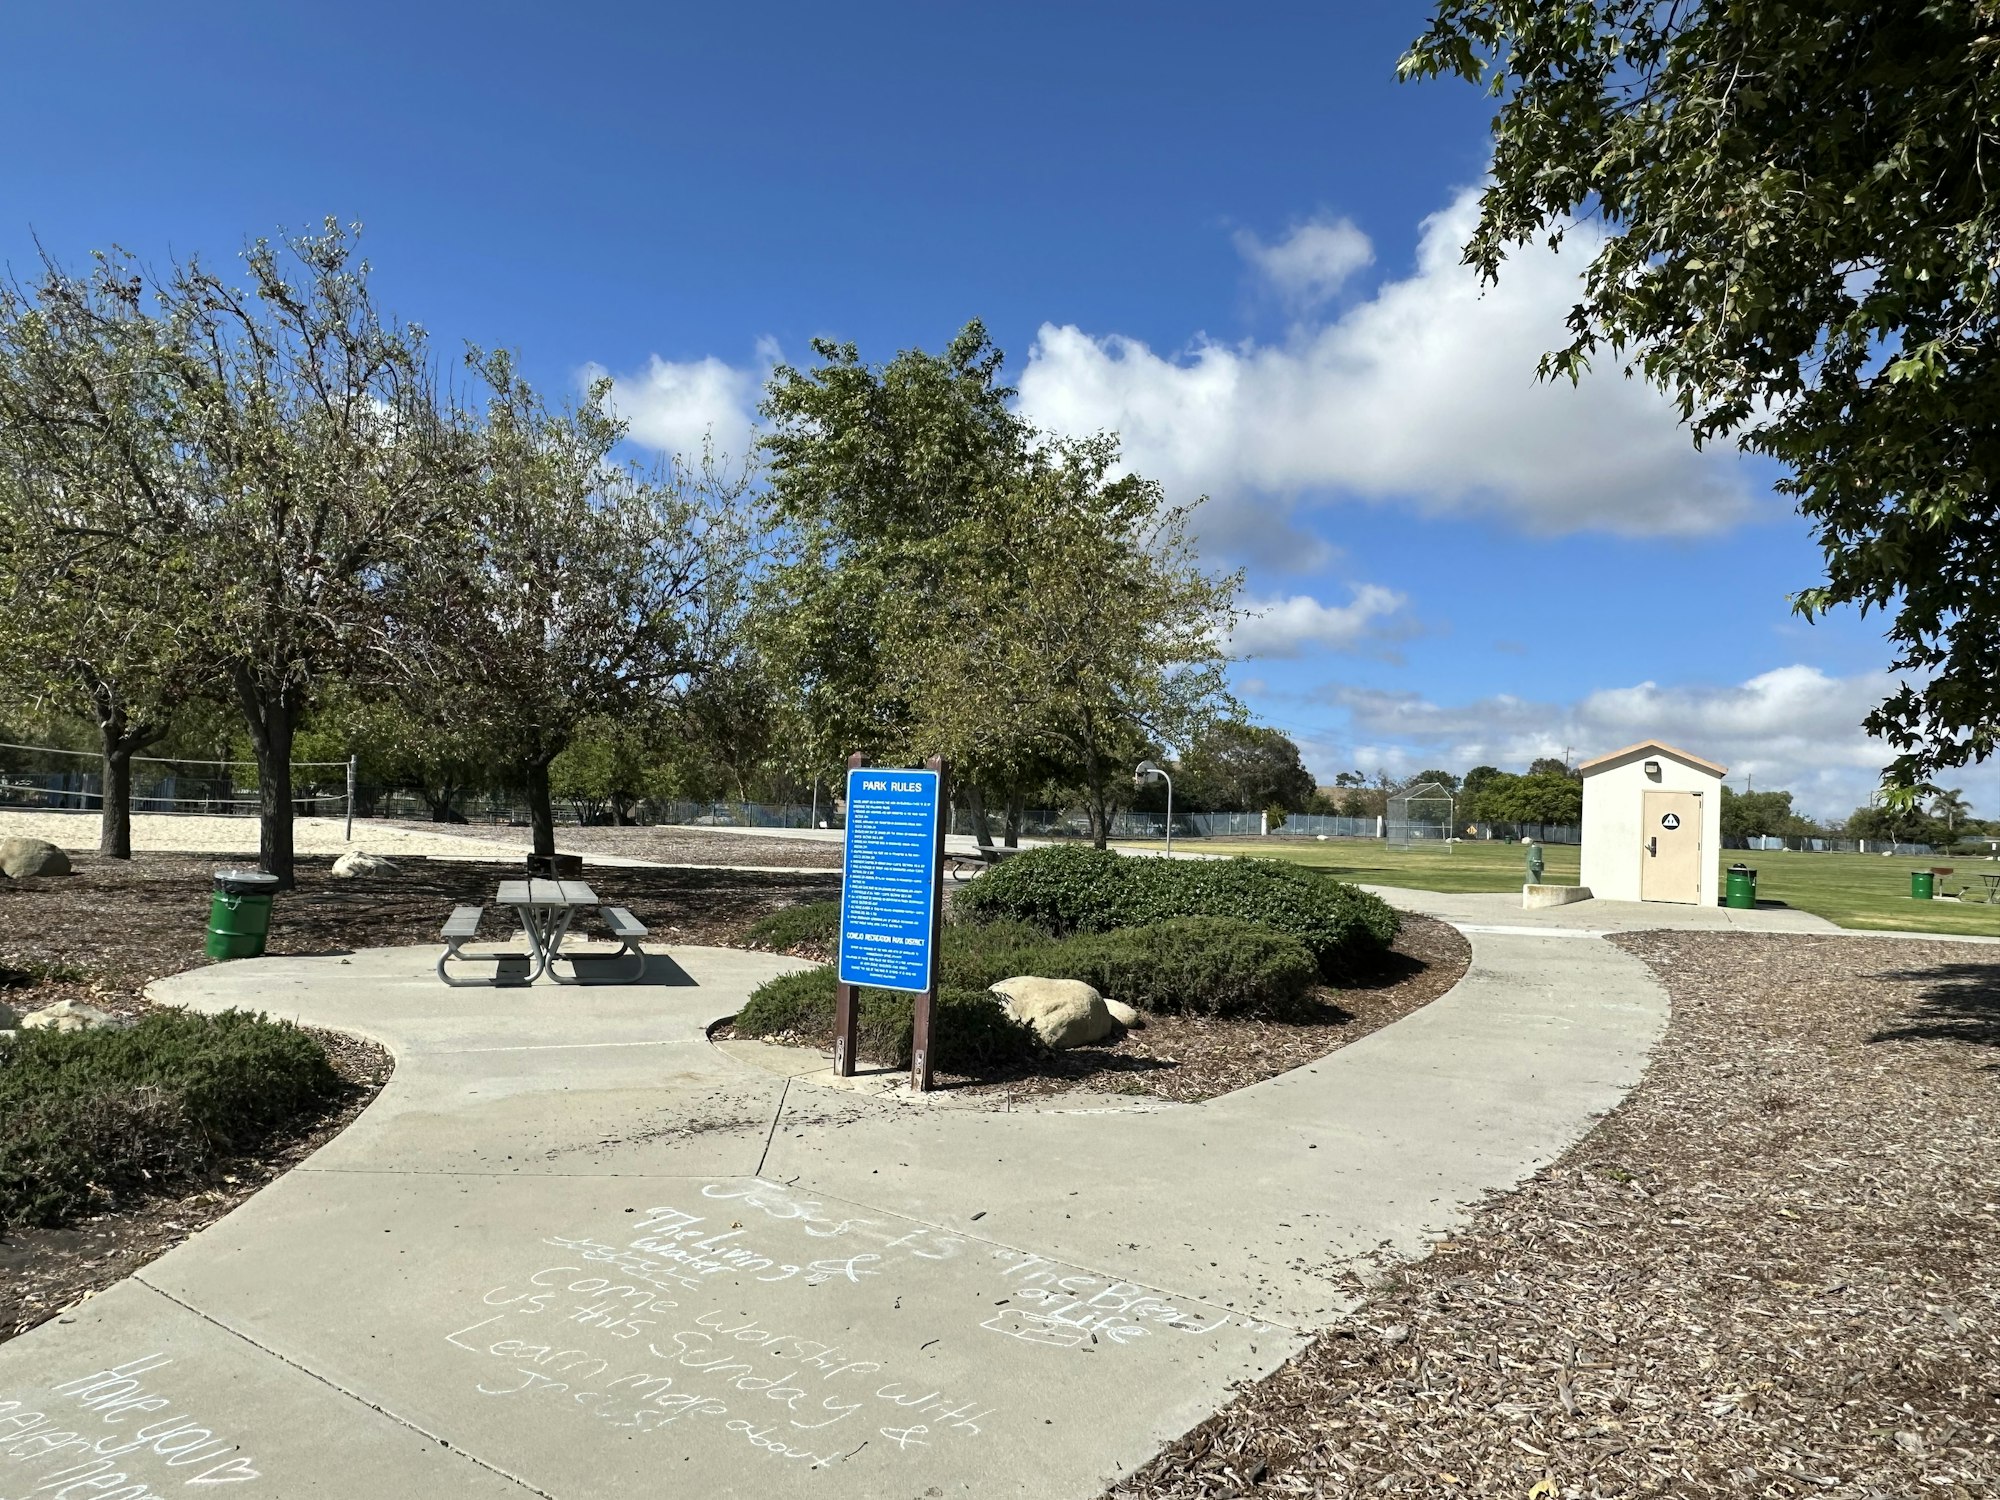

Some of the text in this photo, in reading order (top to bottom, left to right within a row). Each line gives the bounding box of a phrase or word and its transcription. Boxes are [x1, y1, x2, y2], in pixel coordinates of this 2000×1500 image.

[862, 781, 922, 792] PARK RULES
[633, 1206, 706, 1241] The
